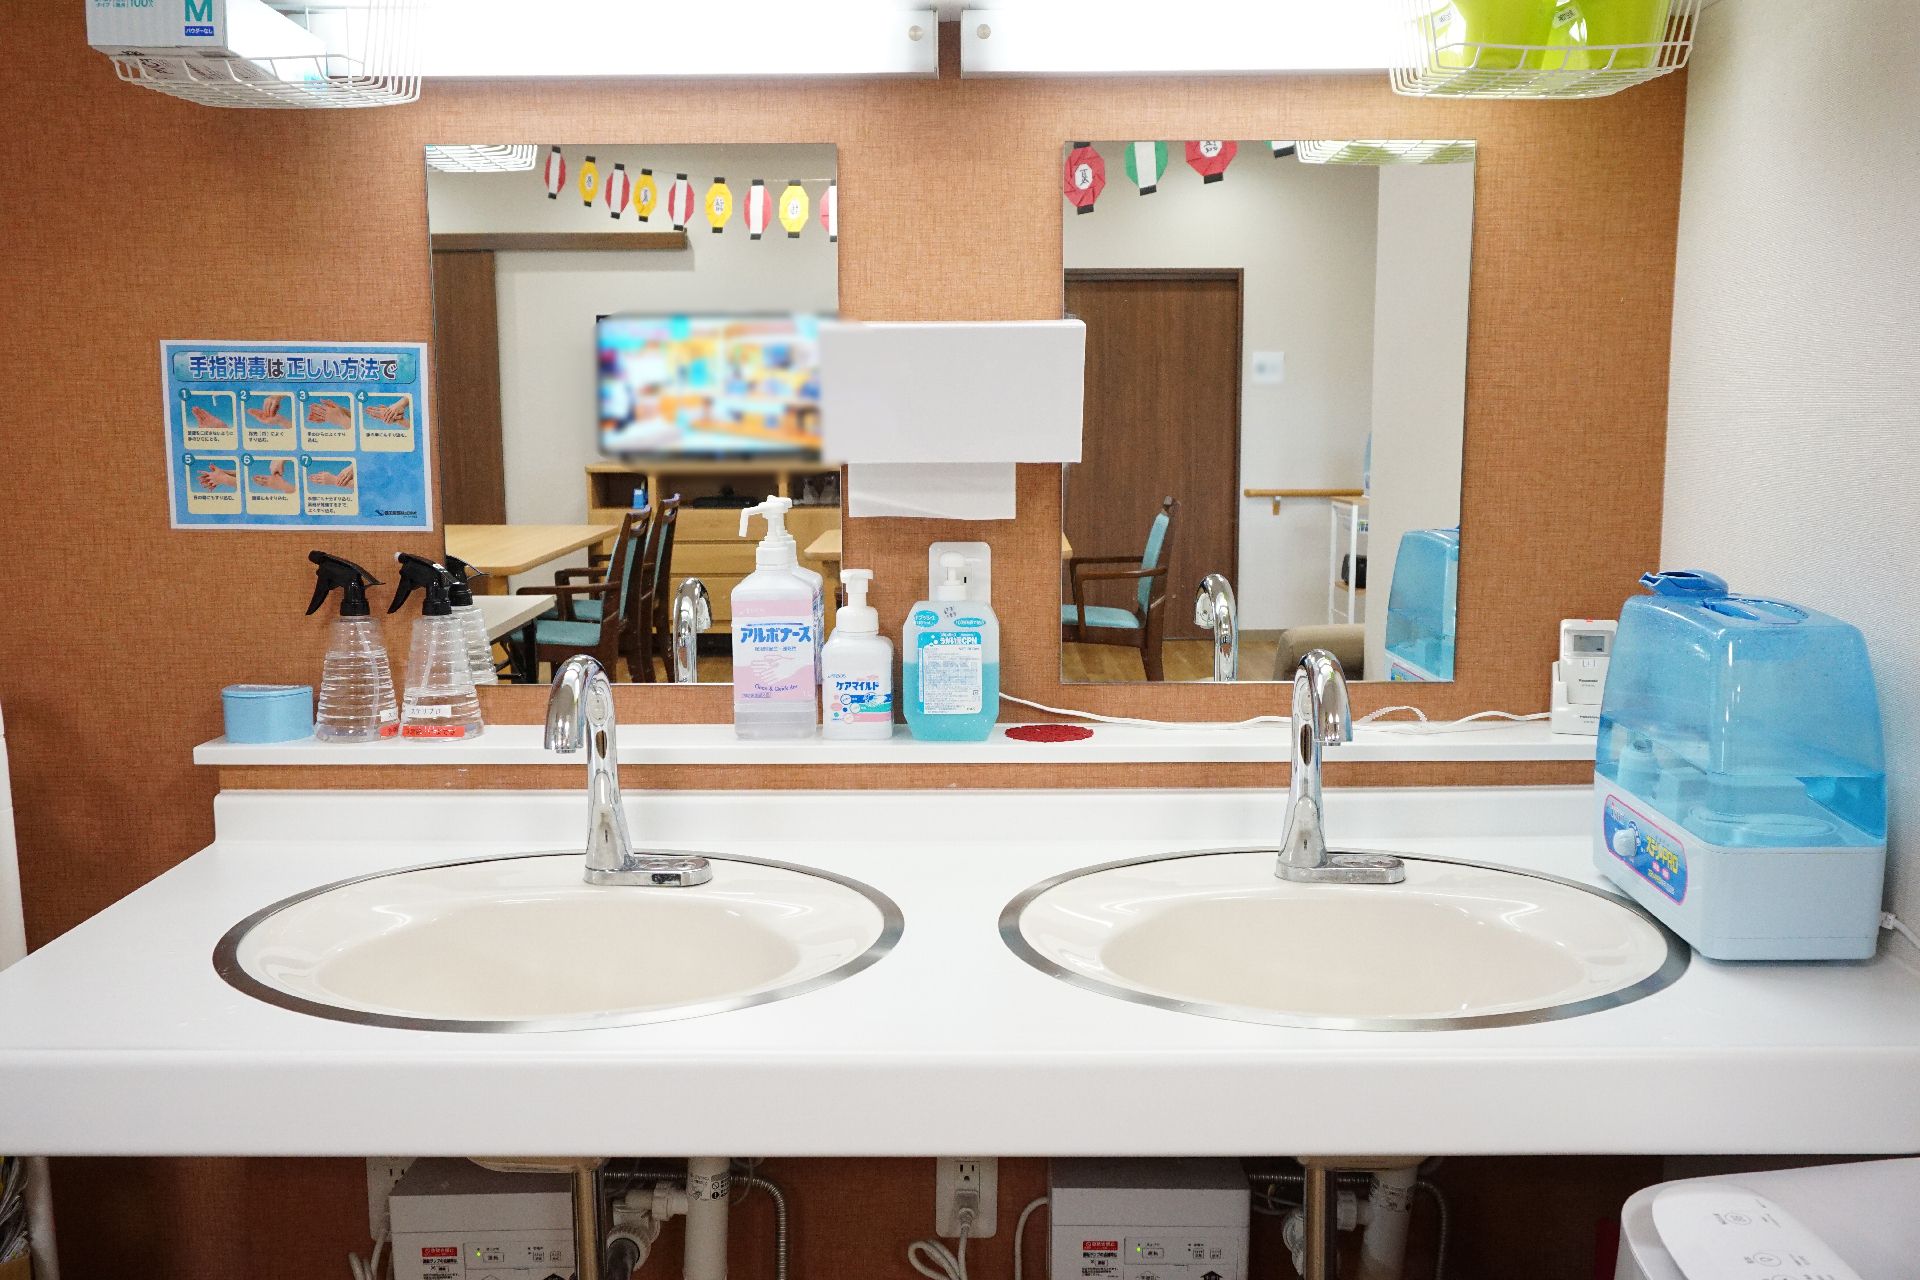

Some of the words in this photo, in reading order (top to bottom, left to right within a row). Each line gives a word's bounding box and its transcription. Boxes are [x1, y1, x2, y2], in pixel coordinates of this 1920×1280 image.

[189, 355, 397, 381] 手指消毒は正しい方法で
[181, 390, 187, 398] 1
[240, 390, 247, 399] 2
[299, 391, 306, 399] 3
[357, 392, 364, 400] 4
[185, 454, 192, 463] 5
[243, 455, 250, 464] 6
[301, 456, 309, 464] 7
[740, 626, 812, 643] アルボナース
[835, 681, 880, 691] ケアマイルド
